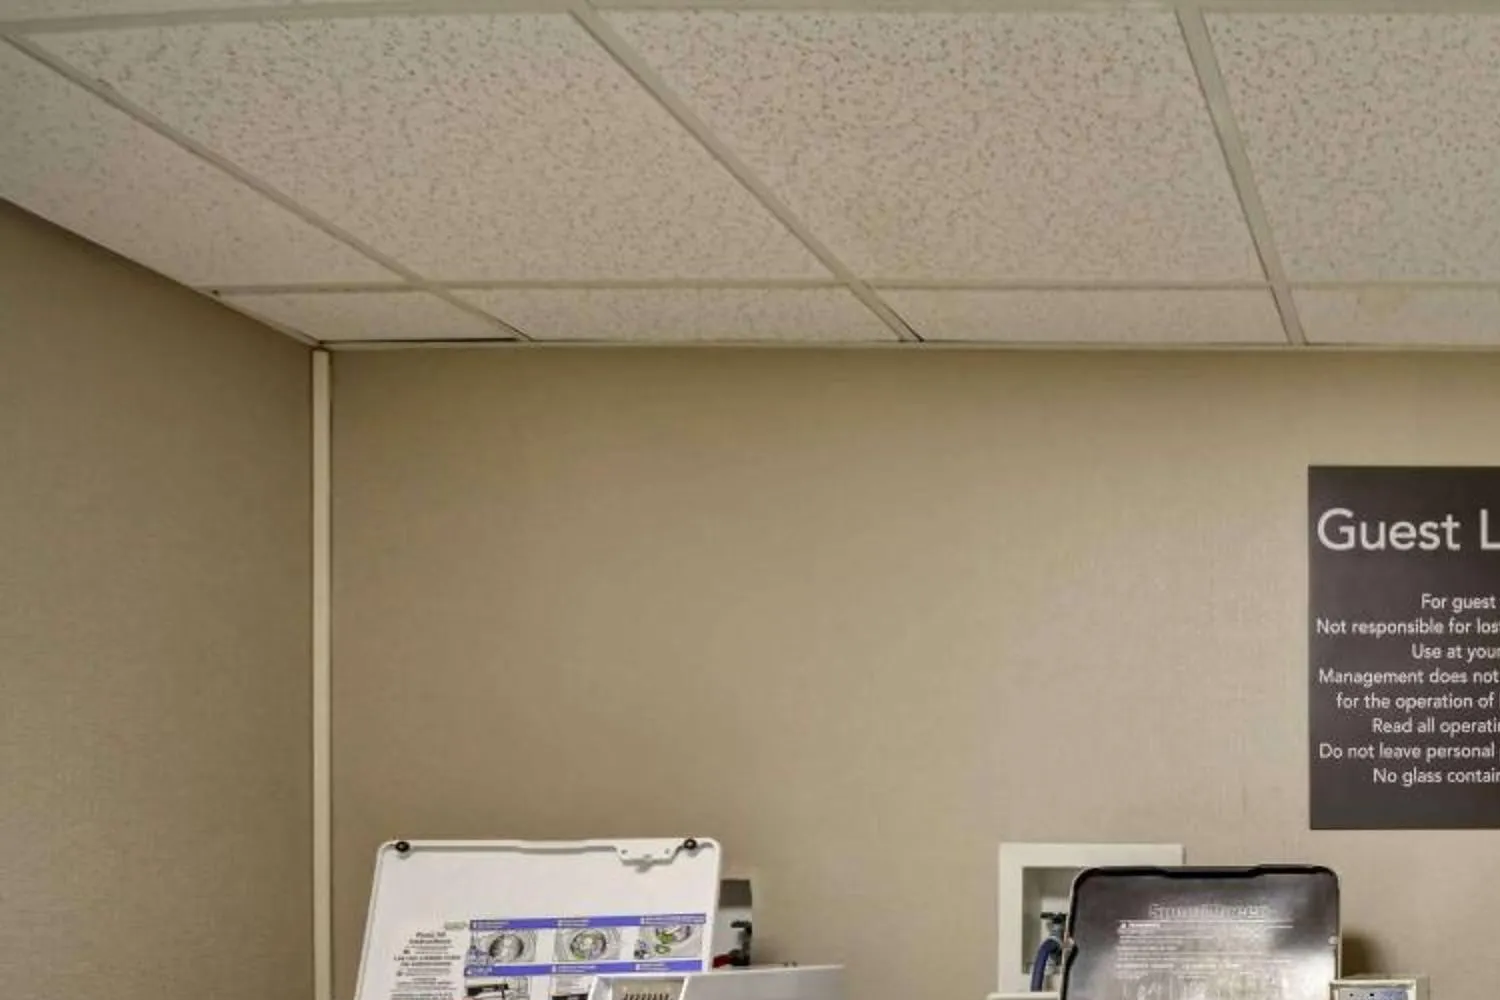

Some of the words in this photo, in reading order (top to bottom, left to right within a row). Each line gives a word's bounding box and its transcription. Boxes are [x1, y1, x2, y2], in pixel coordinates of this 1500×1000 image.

[1317, 508, 1461, 551] Guest
[1422, 593, 1448, 609] For
[1452, 595, 1496, 613] guest
[1317, 618, 1346, 634] Not
[1352, 617, 1444, 638] responsible
[1448, 617, 1472, 634] for
[1412, 643, 1442, 659] Use
[1447, 645, 1462, 659] at
[1319, 668, 1424, 688] Management
[1429, 668, 1468, 684] does
[1473, 669, 1499, 683] not
[1336, 692, 1359, 708] for
[1363, 692, 1390, 709] the
[1395, 692, 1473, 713] operation
[1477, 692, 1495, 709] of
[1372, 717, 1413, 733] Read
[1417, 717, 1435, 733] all
[1320, 743, 1343, 759] Do
[1348, 745, 1375, 759] not
[1380, 742, 1421, 759] leave
[1426, 742, 1495, 763] personal
[1373, 768, 1397, 783] No
[1401, 766, 1442, 787] glass
